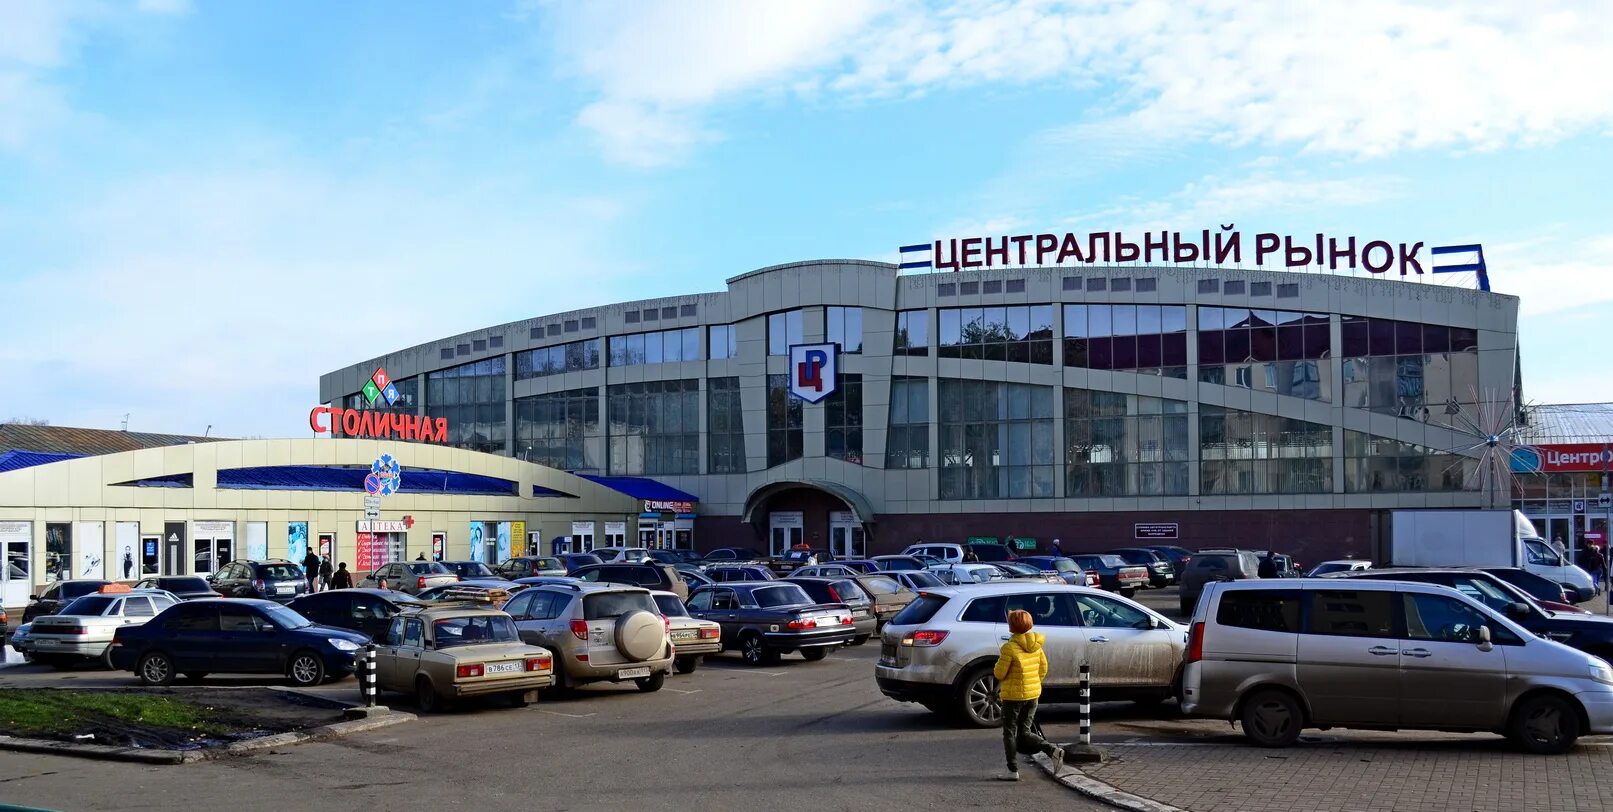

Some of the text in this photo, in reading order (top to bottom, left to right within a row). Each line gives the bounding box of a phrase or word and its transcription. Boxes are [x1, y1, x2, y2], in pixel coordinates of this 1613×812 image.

[934, 223, 1424, 275] ЦЕНТРАЛЬНЫЙ РЫНОК
[310, 407, 447, 441] СТОЛИЧНАЯ
[651, 500, 673, 509] ONLINE
